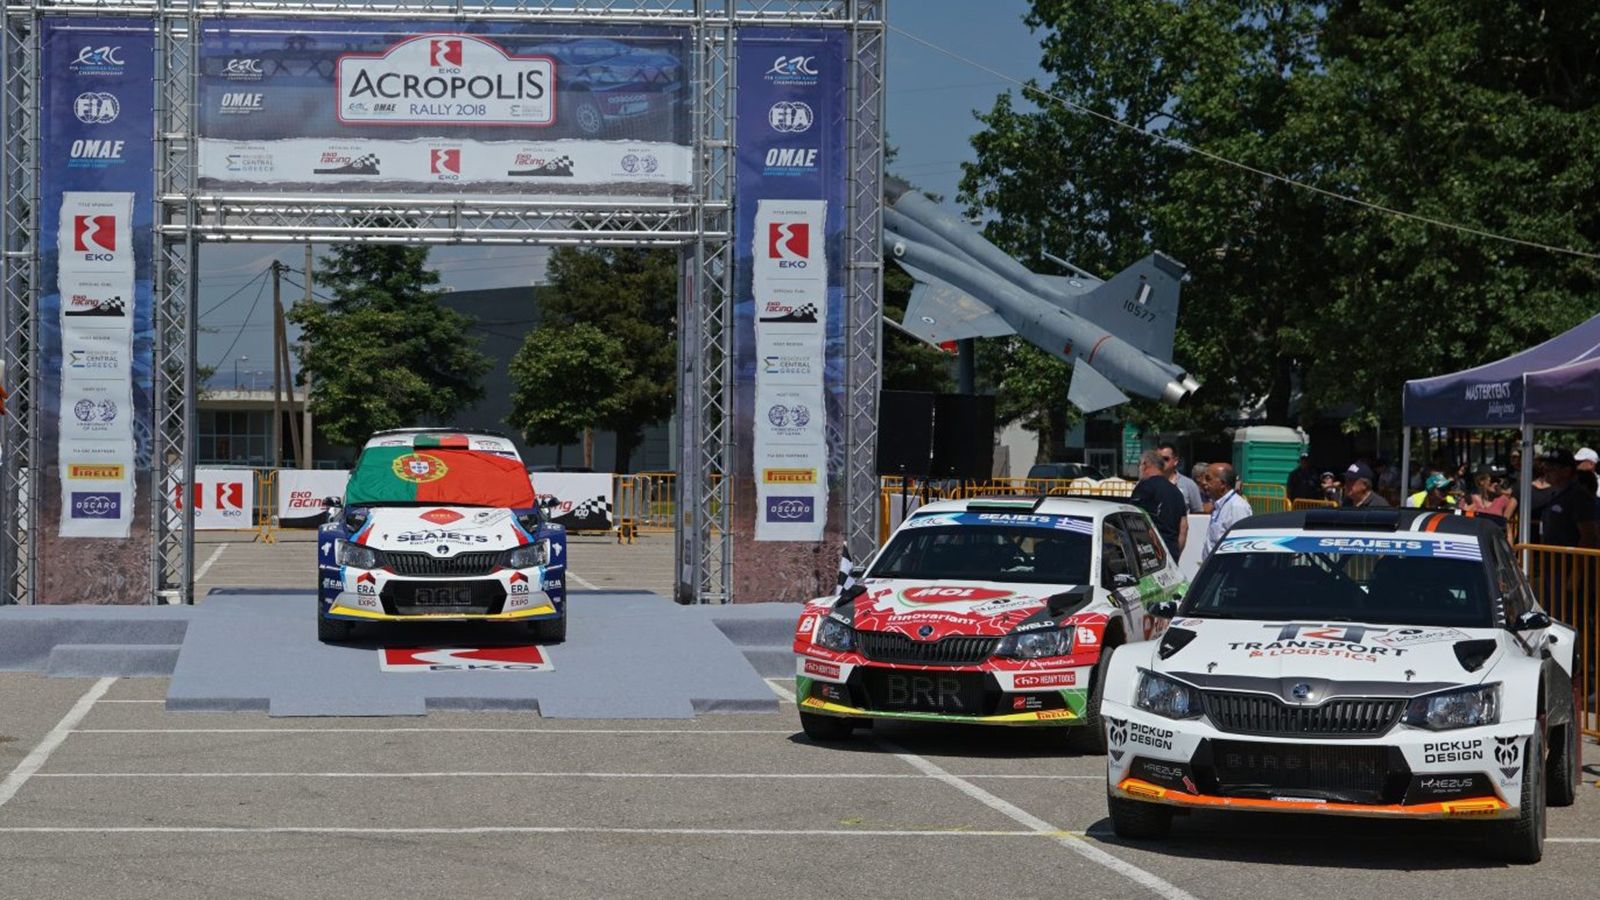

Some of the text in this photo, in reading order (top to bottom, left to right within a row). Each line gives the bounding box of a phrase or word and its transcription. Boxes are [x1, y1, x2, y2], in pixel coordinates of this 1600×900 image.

[349, 68, 544, 100] ACROPOLIS
[221, 93, 263, 106] OMAE
[77, 98, 114, 117] FIA
[410, 104, 486, 116] RALLY 2018
[772, 108, 808, 126] FIA
[70, 139, 125, 158] OMAE
[765, 148, 818, 166] OMAE
[85, 253, 114, 262] EKO
[779, 261, 807, 269] EKO
[1122, 298, 1157, 323] 10577
[1464, 382, 1511, 400] MASTERTENT
[72, 466, 119, 477] PIRELLI
[767, 471, 812, 481] PIRELLI
[288, 498, 327, 510] racin
[978, 513, 1051, 523] SEAJETS
[397, 531, 489, 543] SEAJETS
[1318, 538, 1422, 549] SEAJETS
[357, 585, 375, 593] ERA
[511, 585, 529, 593] ERA
[911, 588, 975, 597] MOL
[1228, 640, 1408, 657] TRANSPORT
[1249, 647, 1378, 663] & LOGISTICS
[1040, 674, 1075, 683] HEAVY TOOLS
[888, 675, 963, 707] BRR
[1131, 722, 1174, 738] PICKUP
[1130, 733, 1172, 750] DESIGN
[1424, 739, 1482, 752] PICKUP
[1425, 750, 1483, 764] DESIGN
